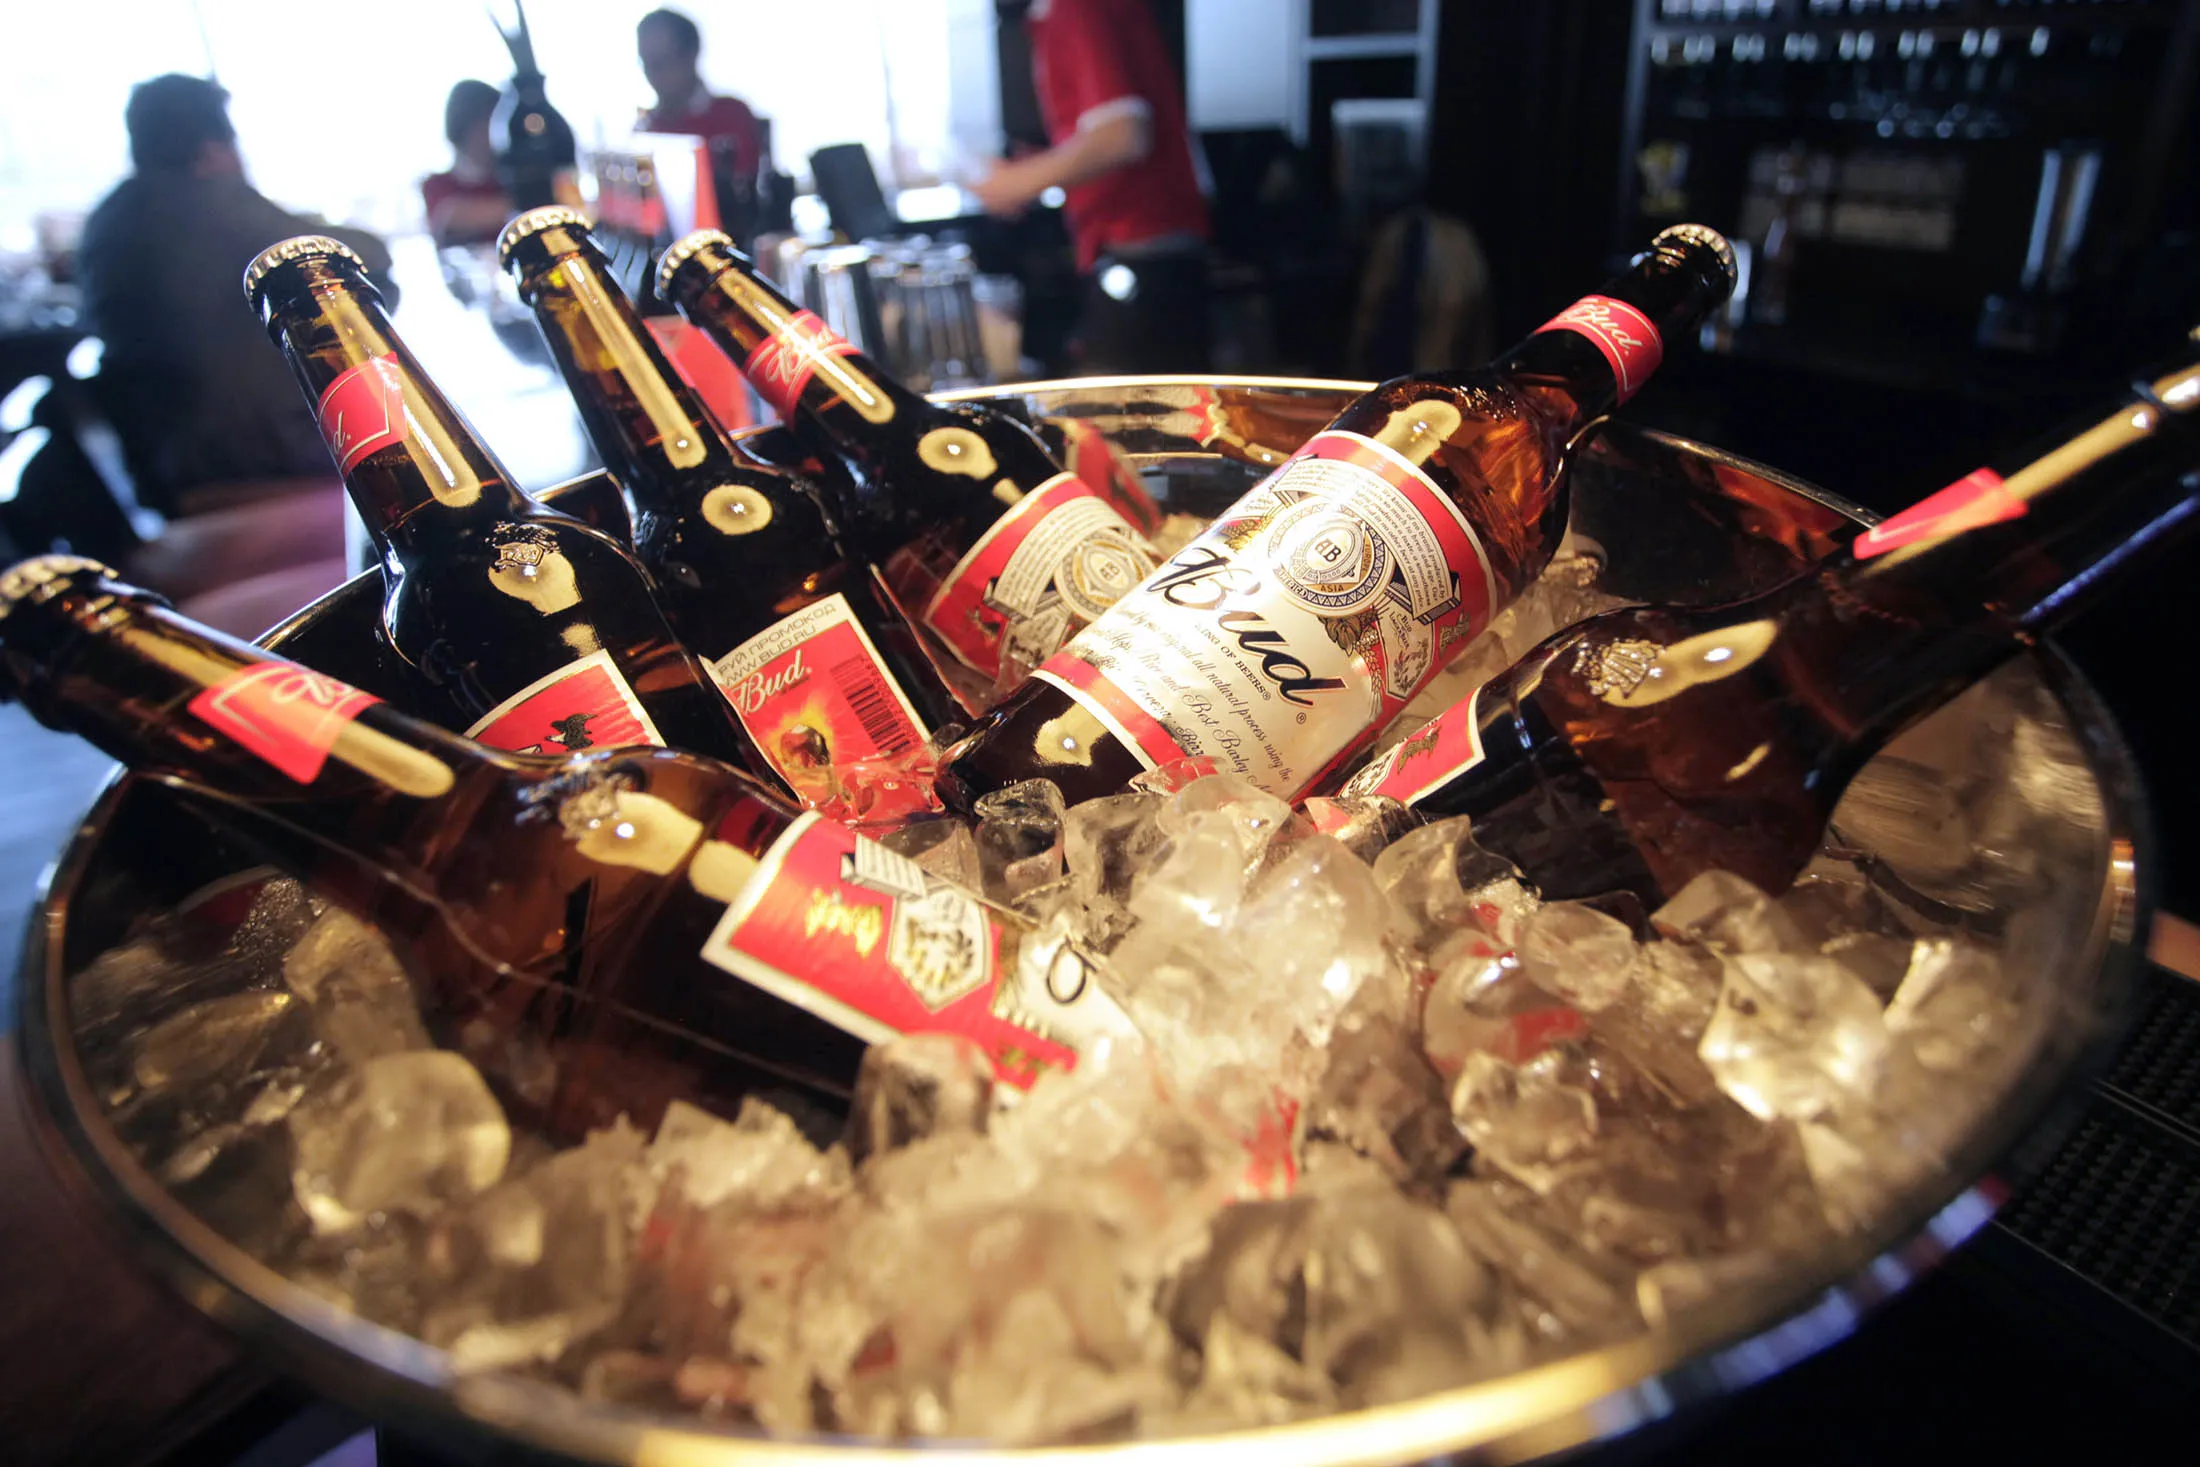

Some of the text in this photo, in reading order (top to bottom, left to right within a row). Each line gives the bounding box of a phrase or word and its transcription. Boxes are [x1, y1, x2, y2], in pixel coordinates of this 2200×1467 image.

[1315, 539, 1342, 562] AB
[1320, 585, 1345, 593] ASIA
[749, 603, 837, 654] ПРОМОКОД
[1220, 645, 1237, 660] OF
[1161, 675, 1190, 692] and
[1182, 694, 1220, 727] Best
[1212, 729, 1250, 773] Barley
[1192, 660, 1217, 671] all
[1206, 672, 1248, 706] natural
[1229, 708, 1267, 741] process
[1264, 744, 1284, 769] using
[1279, 768, 1293, 782] the
